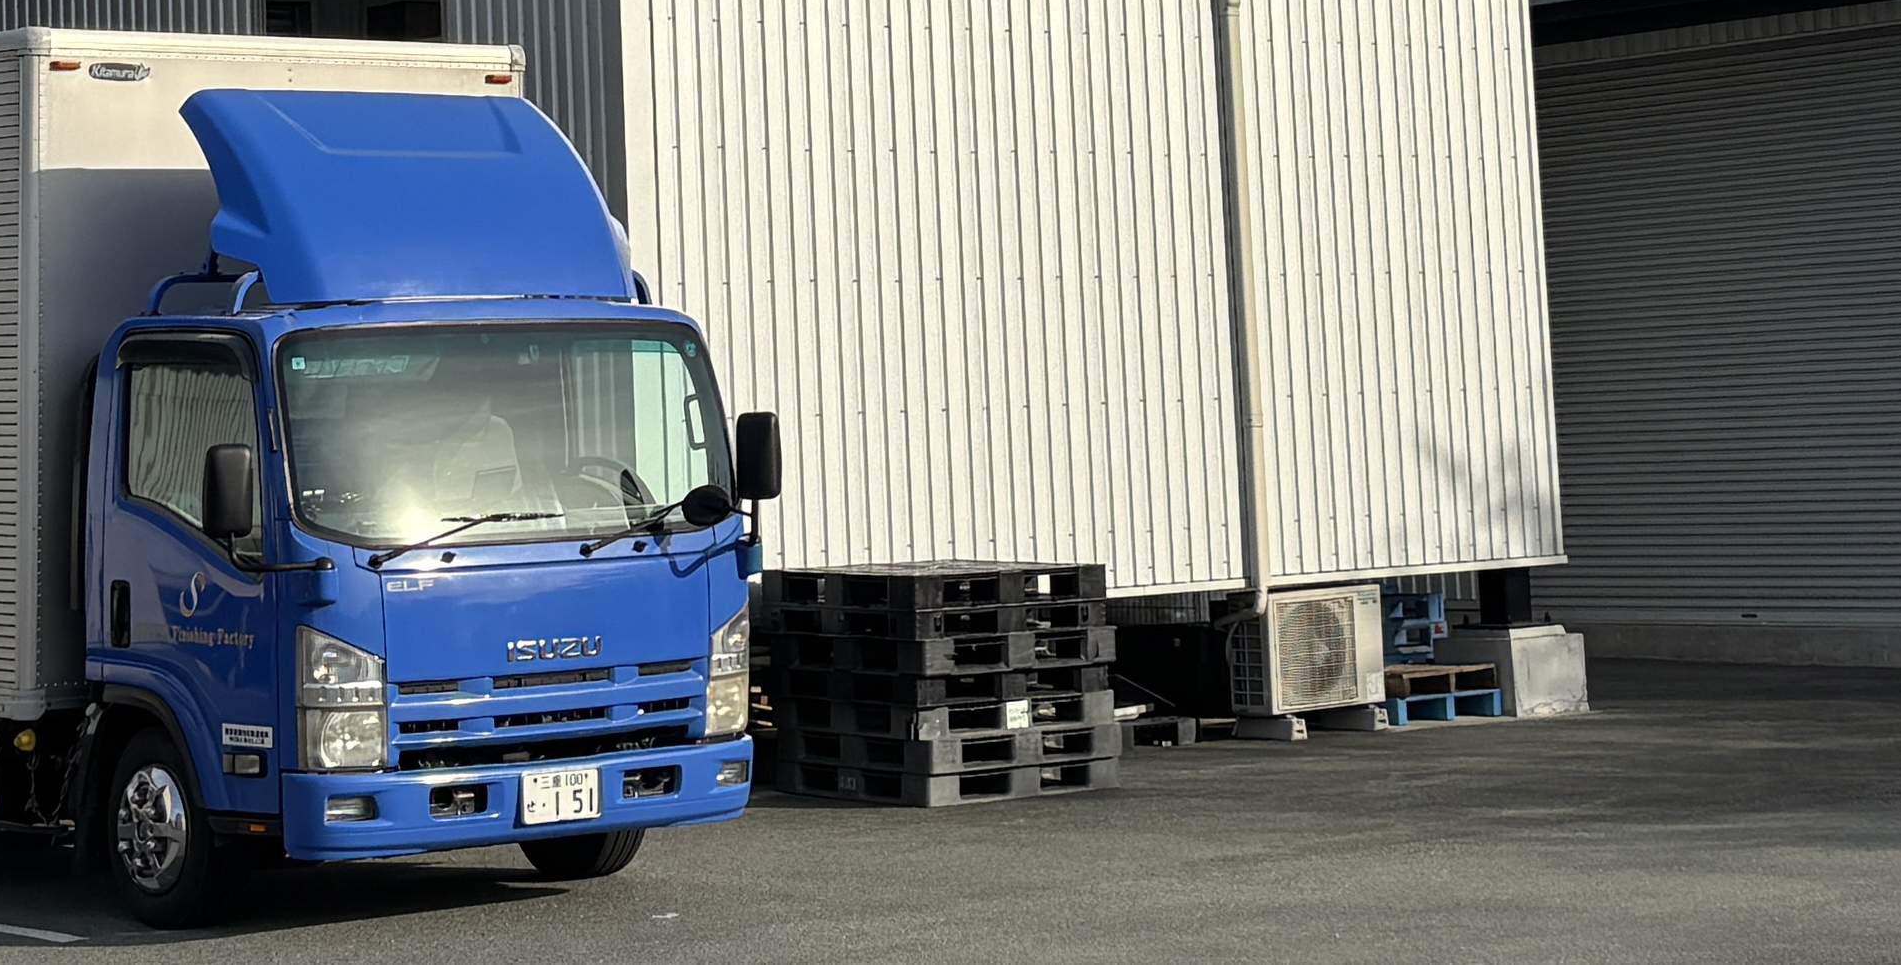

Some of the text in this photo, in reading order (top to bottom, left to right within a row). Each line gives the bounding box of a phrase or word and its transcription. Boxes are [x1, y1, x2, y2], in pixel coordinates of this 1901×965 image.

[91, 64, 135, 79] Kitamura
[217, 628, 255, 650] Factory
[506, 635, 602, 663] ISUZU
[540, 773, 584, 789] 三重 100
